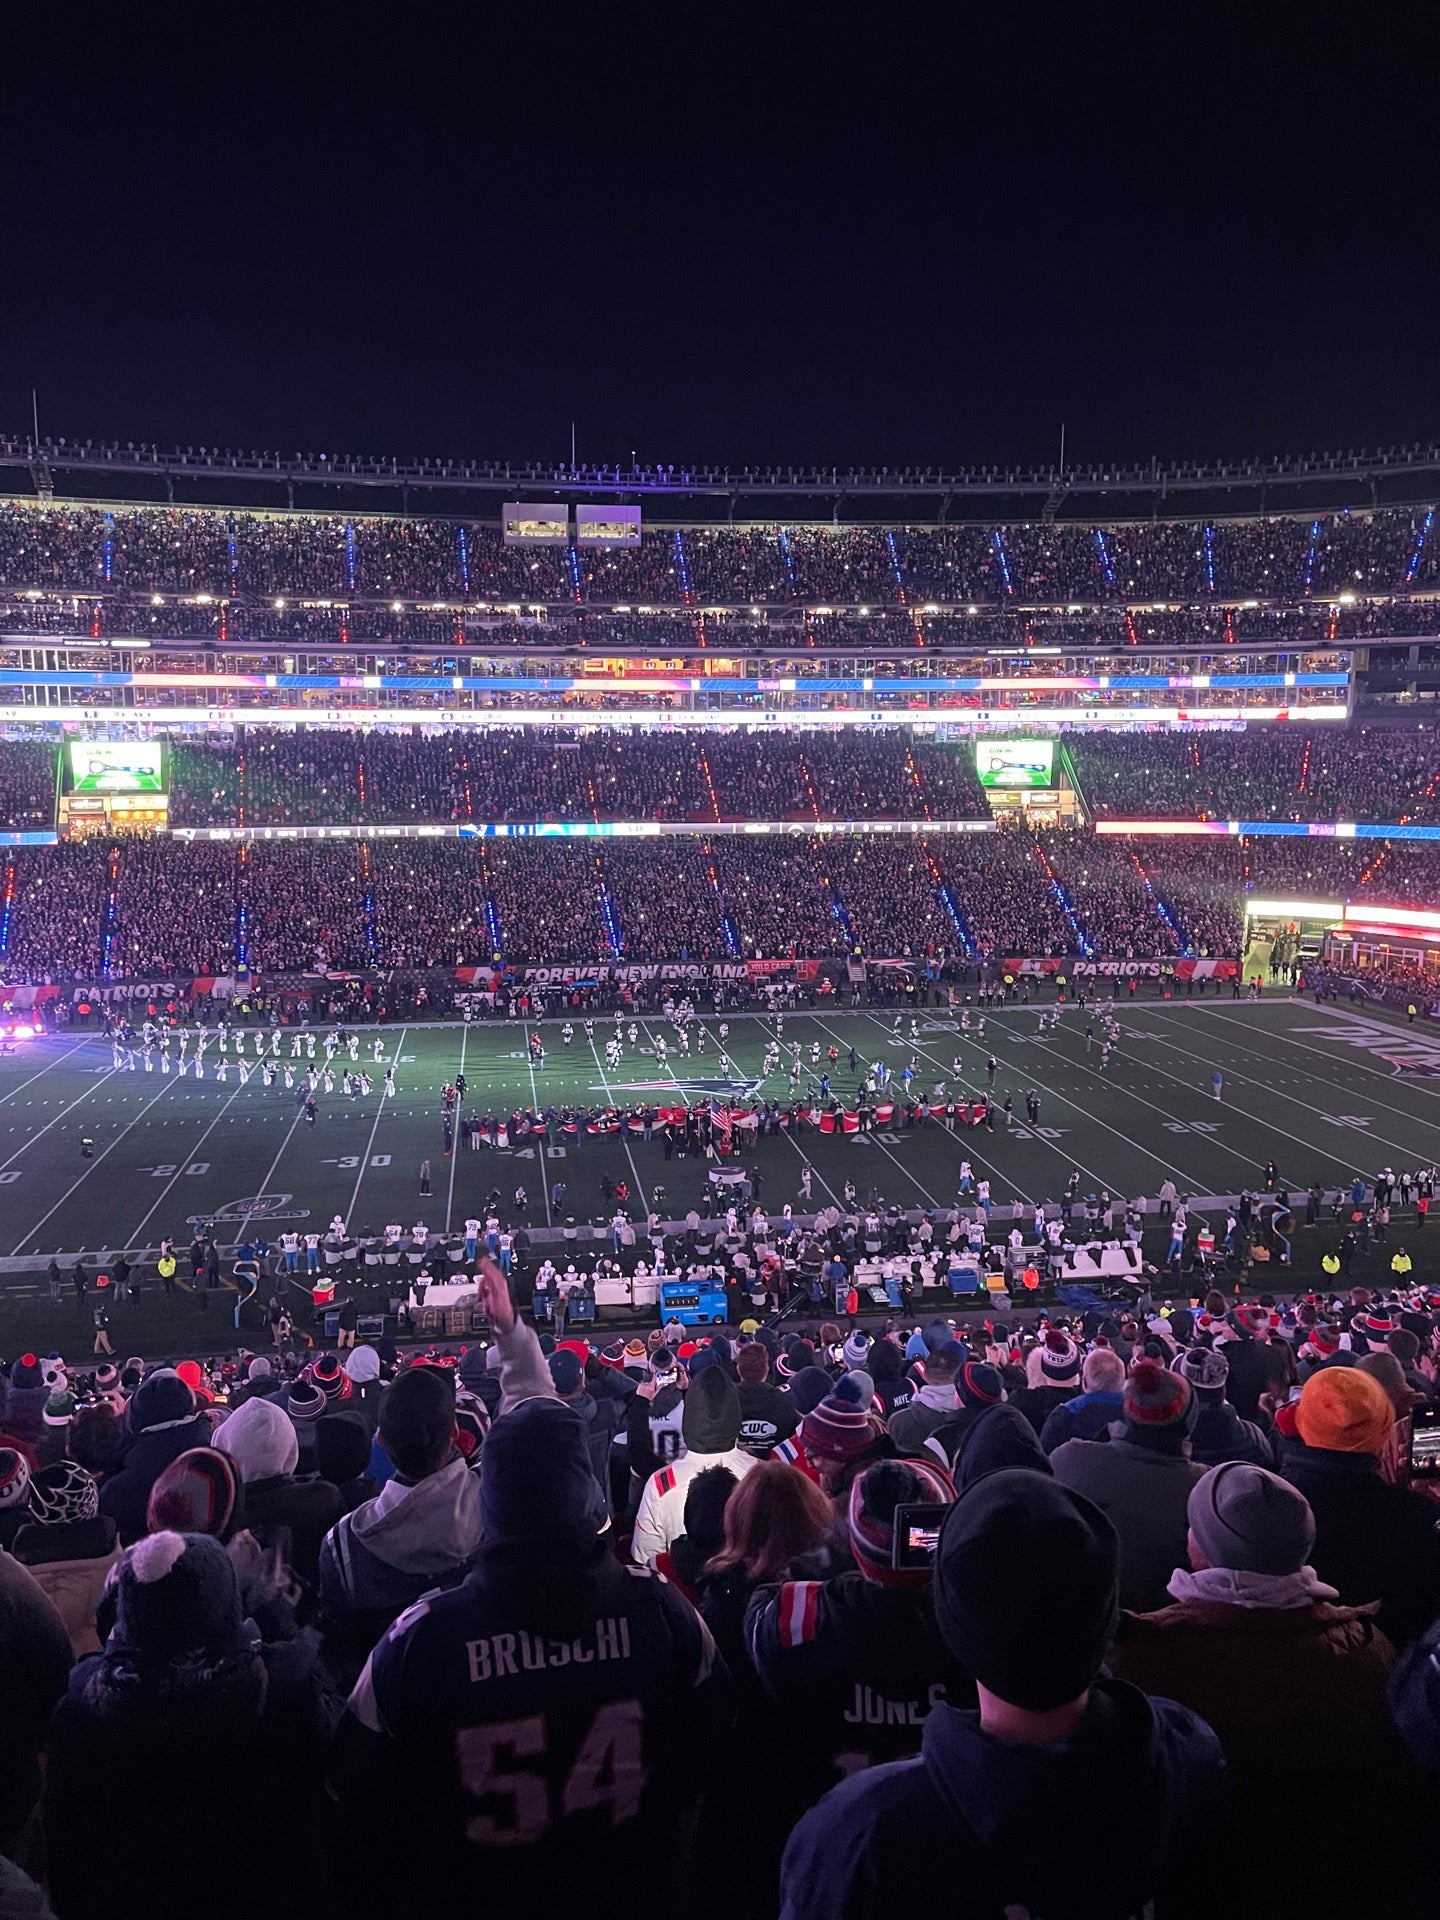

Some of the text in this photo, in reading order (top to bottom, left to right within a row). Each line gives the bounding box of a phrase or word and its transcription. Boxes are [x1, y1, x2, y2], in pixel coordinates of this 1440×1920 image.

[1309, 824, 1335, 835] Drake
[772, 962, 791, 970] CARD
[1072, 961, 1161, 976] PATRIOTS
[524, 966, 609, 982] FOREVER
[614, 965, 660, 980] NEW
[73, 983, 176, 1002] PATRIOTS
[1162, 1121, 1217, 1133] 20
[1320, 1115, 1370, 1126] 10
[850, 1133, 901, 1145] 40
[1007, 1127, 1062, 1139] 30
[514, 1146, 567, 1159] 40
[337, 1154, 392, 1168] 30
[150, 1163, 211, 1177] 20
[455, 1697, 652, 1848] 54
